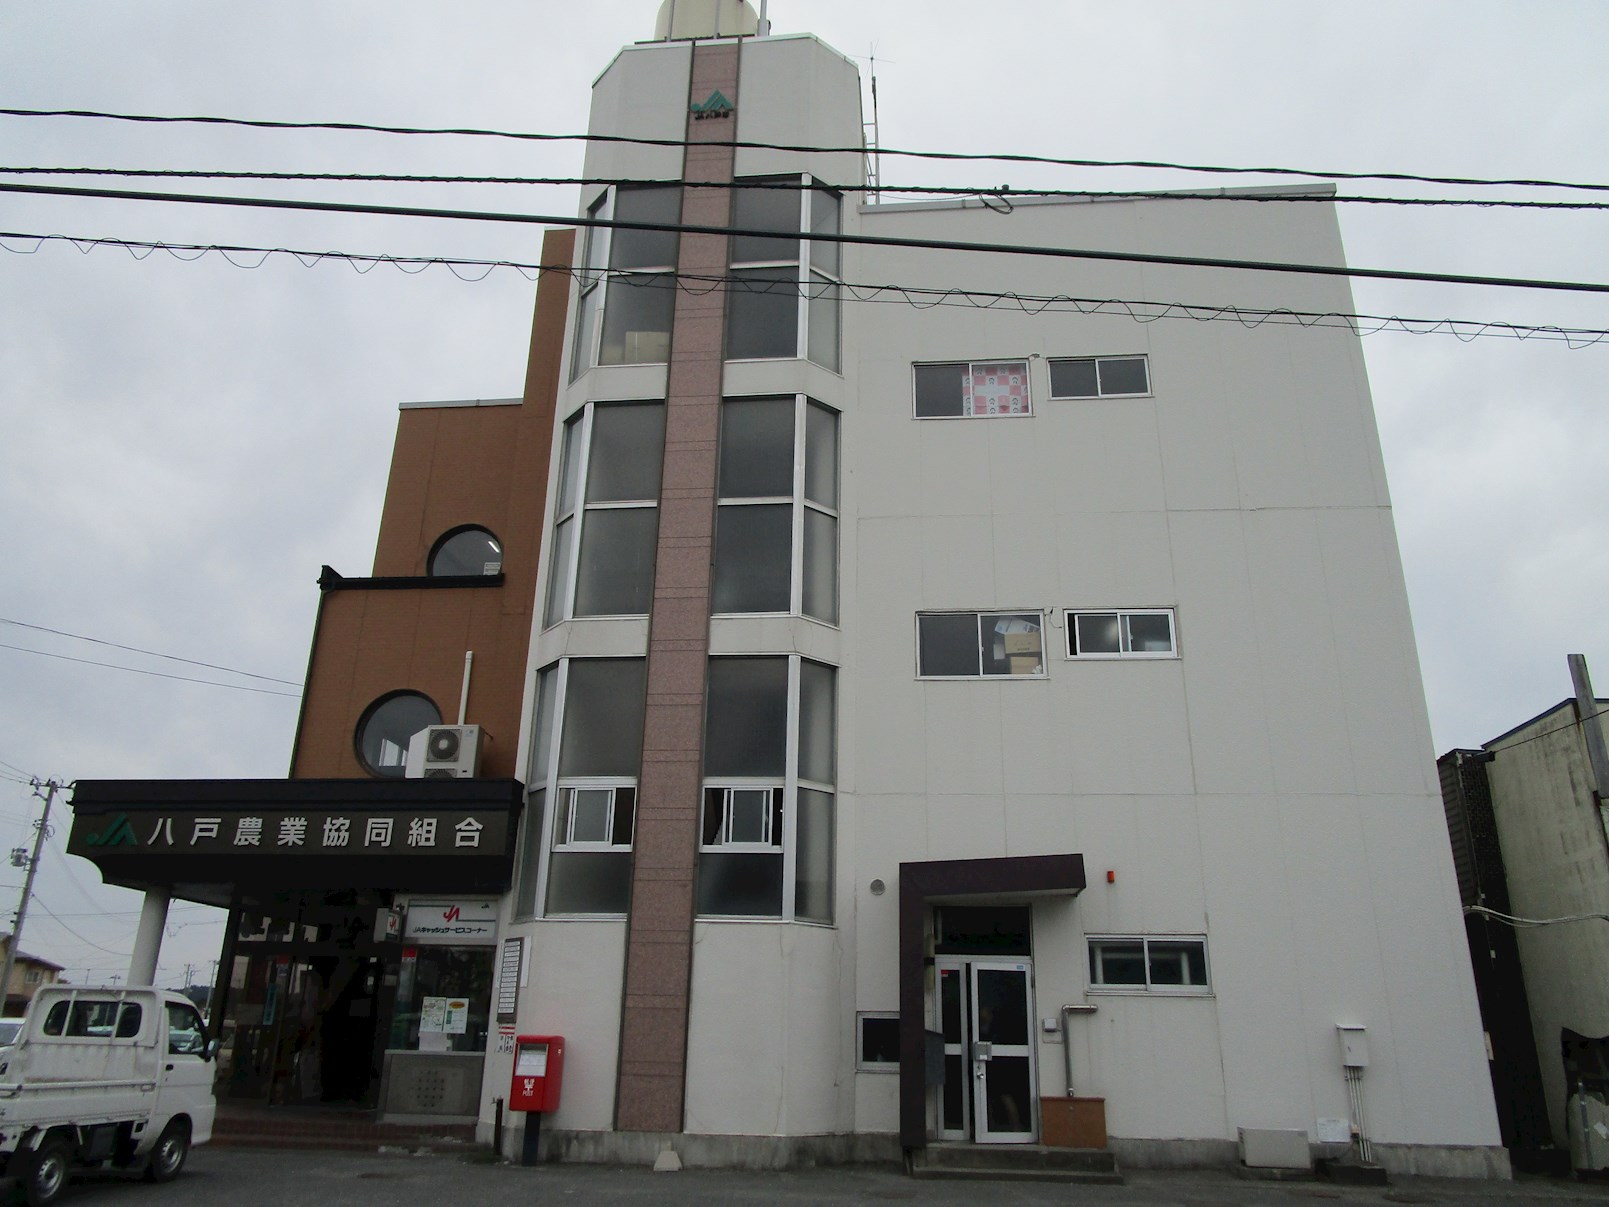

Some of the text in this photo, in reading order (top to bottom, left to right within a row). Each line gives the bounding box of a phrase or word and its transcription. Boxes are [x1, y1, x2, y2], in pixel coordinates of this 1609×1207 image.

[146, 816, 484, 848] 八戸農業協同組合
